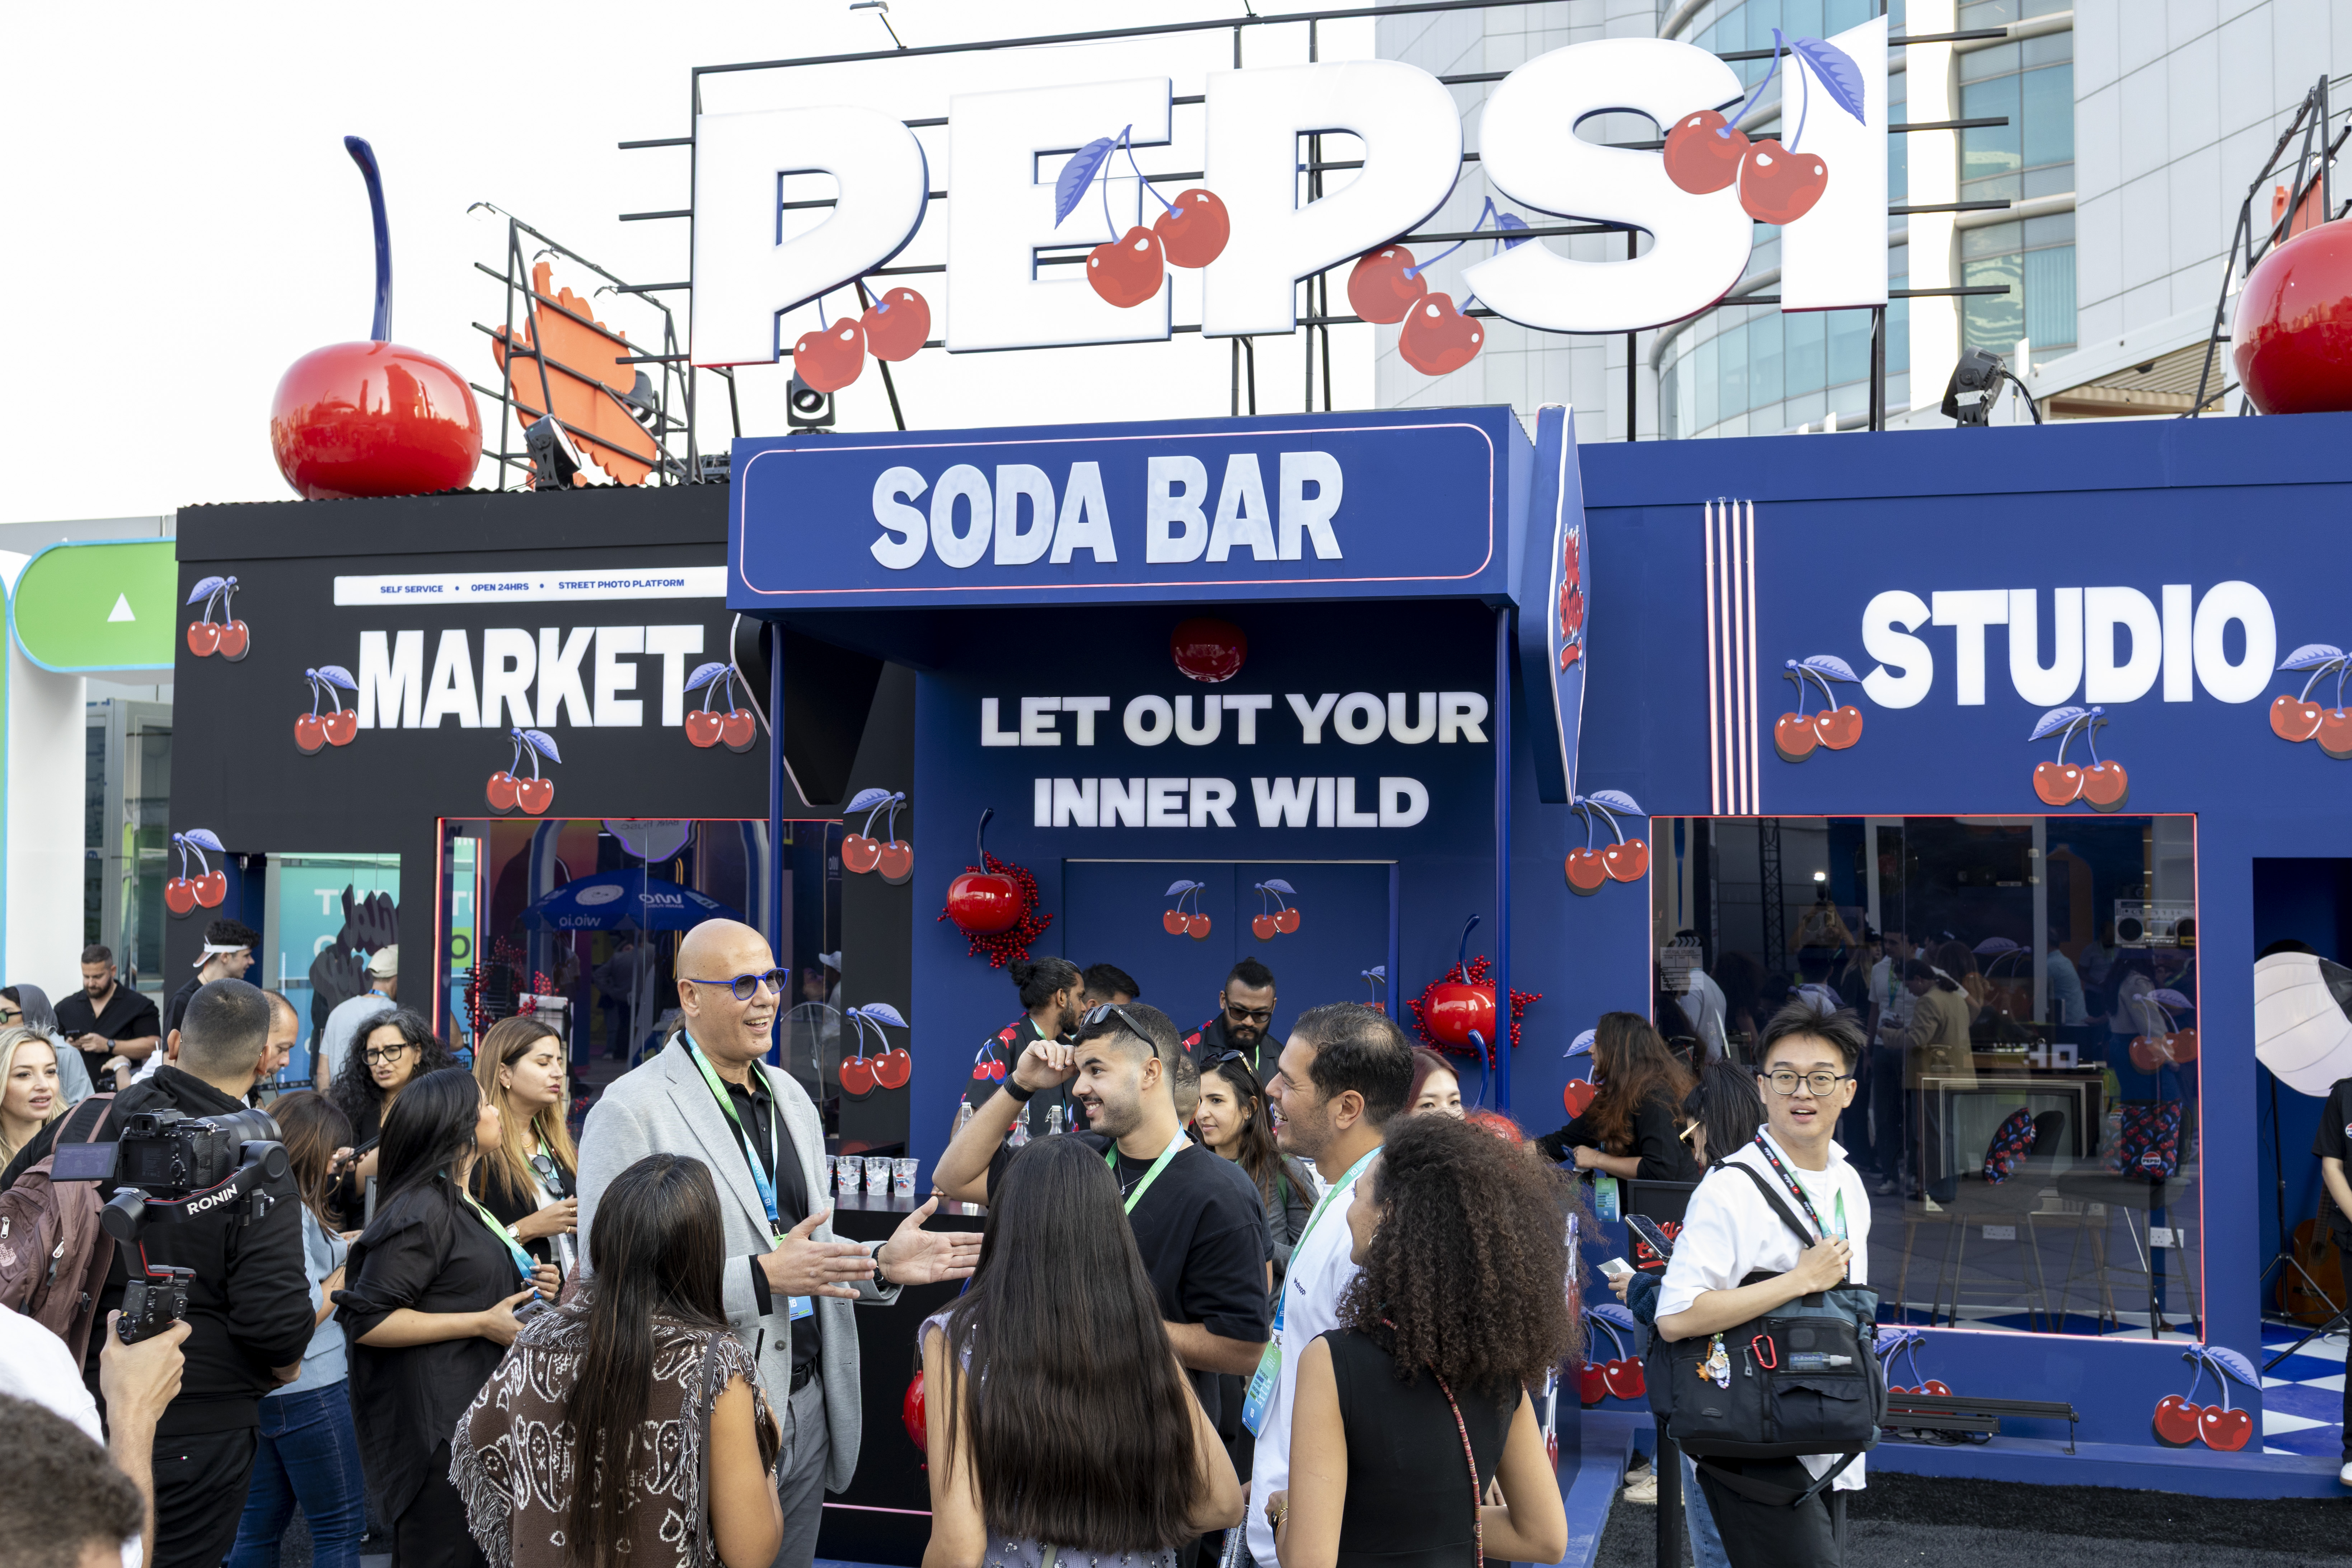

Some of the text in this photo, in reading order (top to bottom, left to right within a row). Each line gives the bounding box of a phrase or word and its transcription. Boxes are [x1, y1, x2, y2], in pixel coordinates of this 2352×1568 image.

[691, 14, 1887, 366] PEPSI
[871, 451, 1343, 569] SODA BAR
[558, 581, 595, 589] STREET
[1861, 581, 2276, 708] STUDIO
[358, 625, 704, 729] MARKET
[981, 692, 1489, 746] LET OUT YOUR
[1034, 777, 1429, 828] INNER WILD
[700, 1058, 715, 1080] EMAAR
[721, 1094, 729, 1104] 1B
[751, 1157, 763, 1181] EMAAR
[1348, 1167, 1359, 1177] 1B
[187, 1184, 238, 1215] RONIN
[764, 1198, 772, 1207] 1B
[1135, 1187, 1144, 1196] 1B
[0, 1243, 10, 1258] NORTH
[789, 1298, 797, 1308] 1B
[1250, 1408, 1255, 1418] 1B
